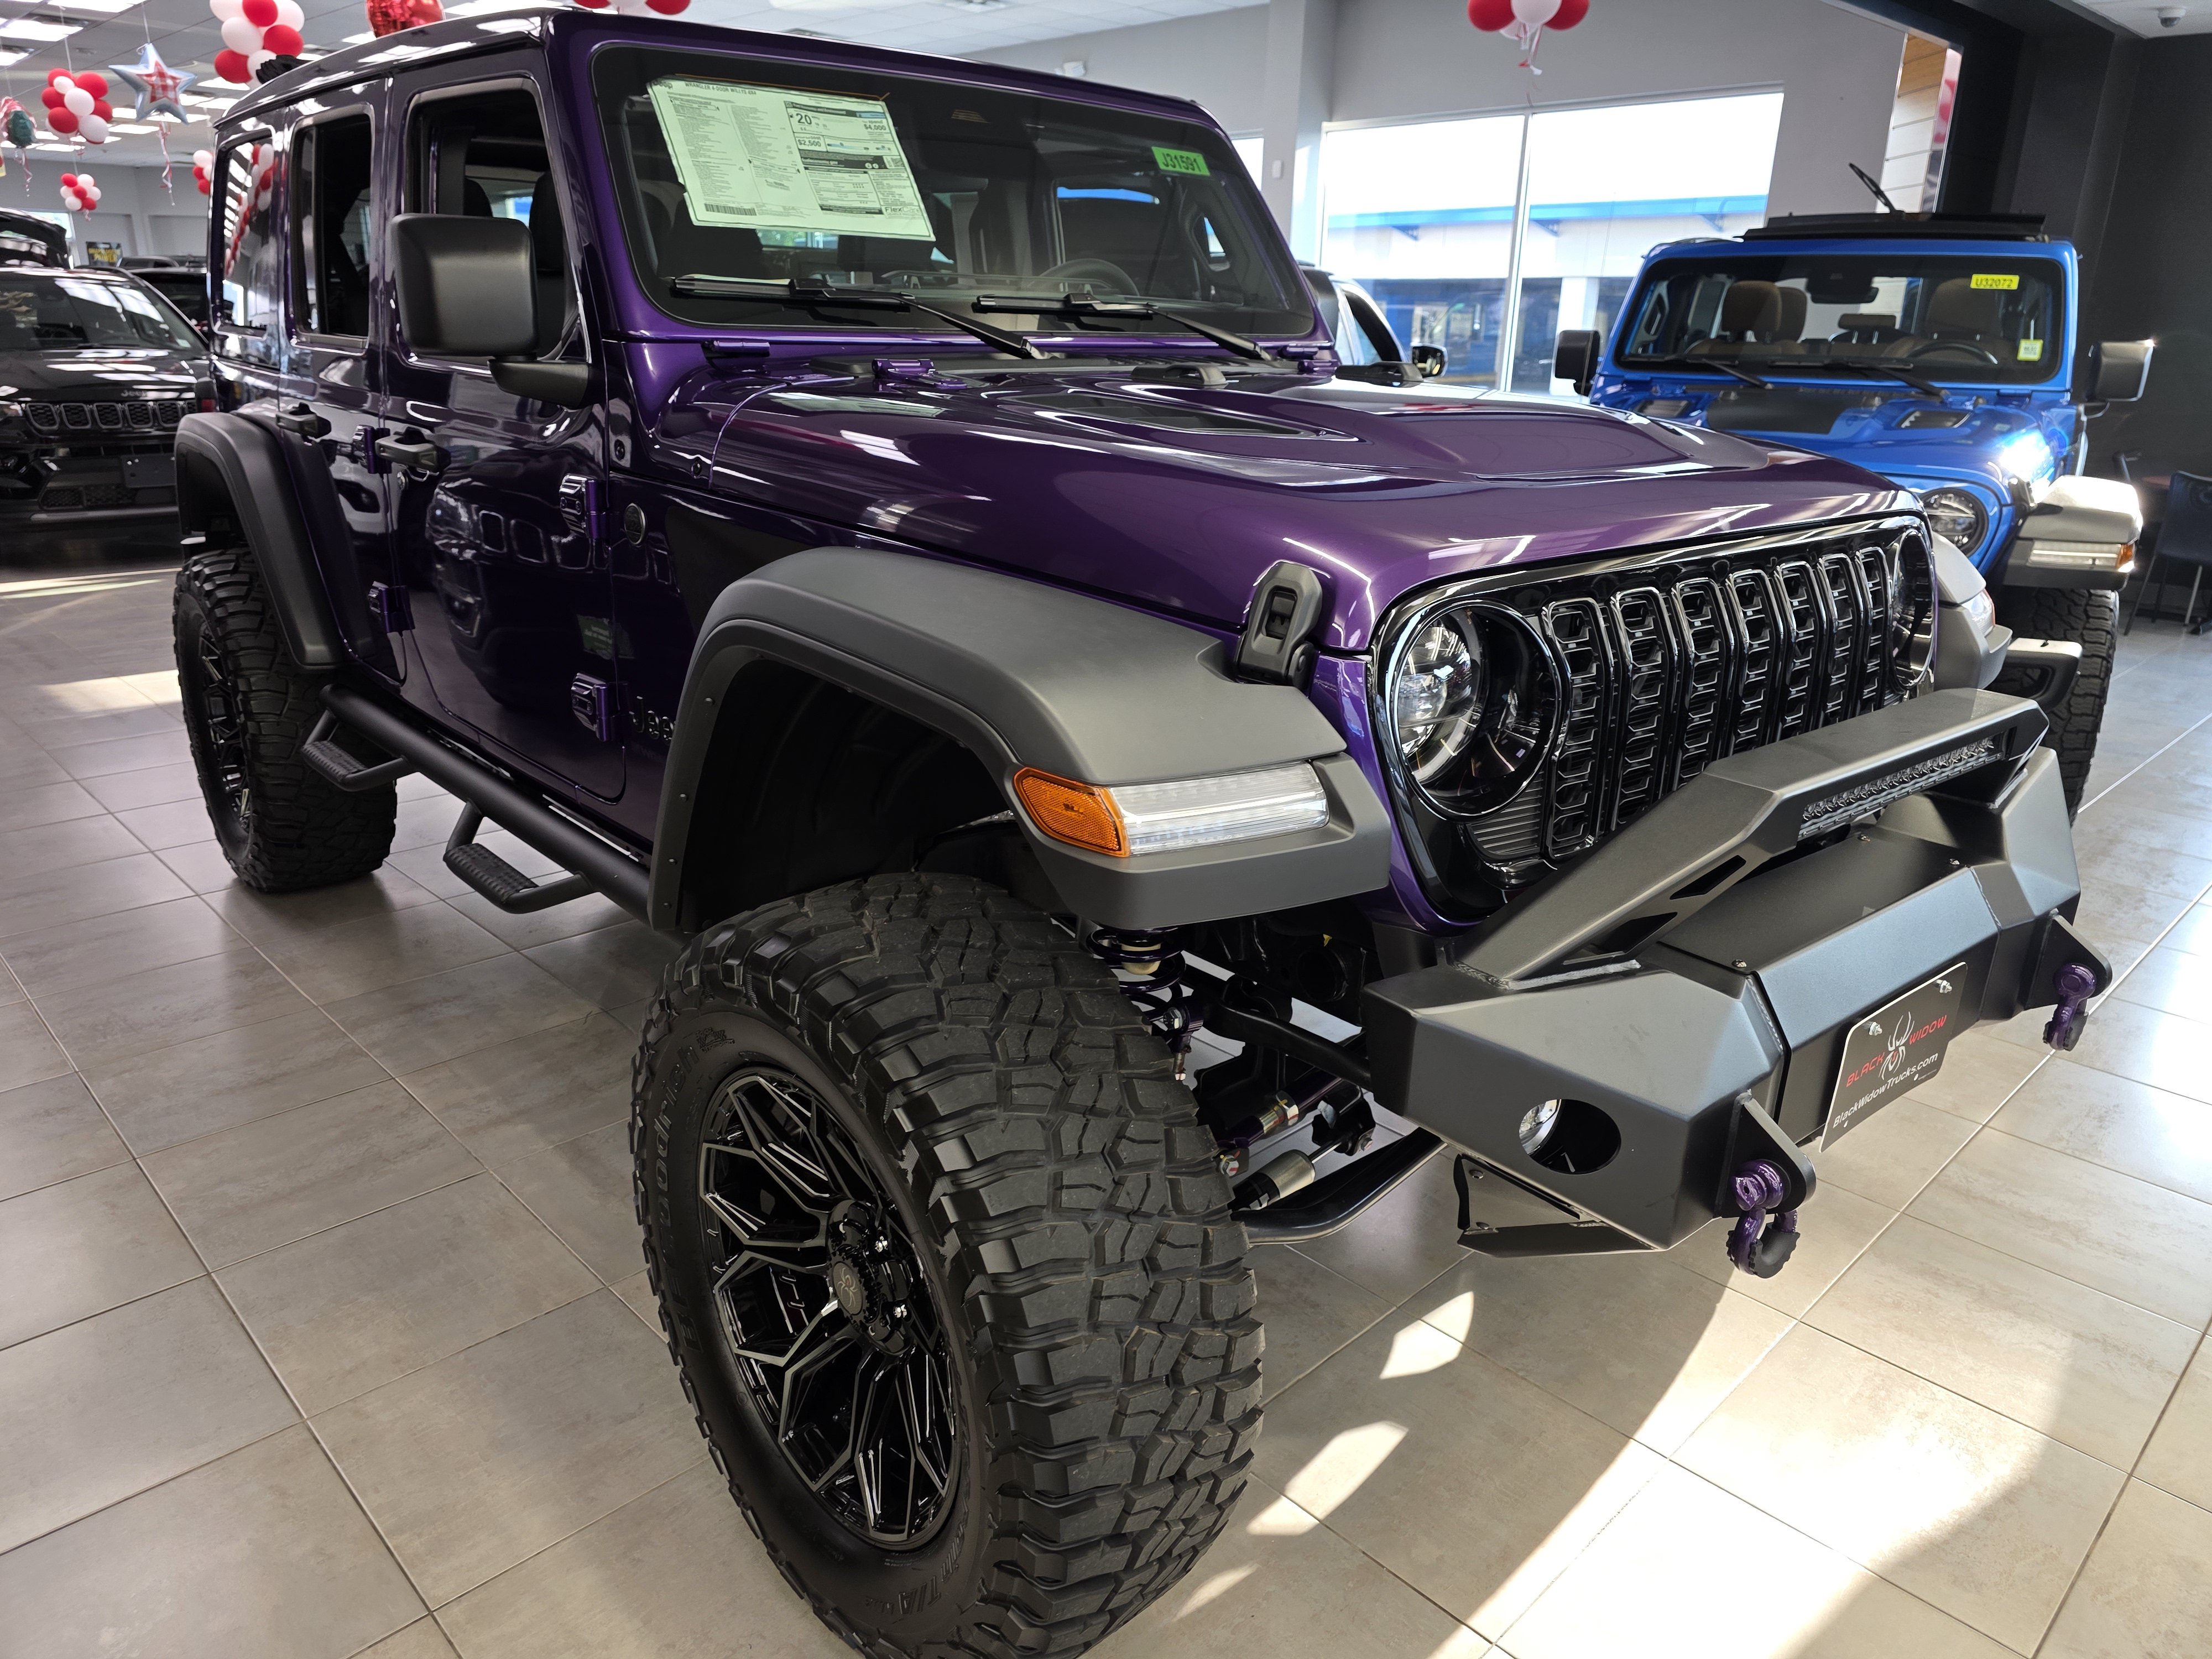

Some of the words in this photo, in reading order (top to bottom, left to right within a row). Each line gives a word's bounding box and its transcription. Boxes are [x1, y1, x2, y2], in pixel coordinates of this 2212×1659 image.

[795, 112, 812, 126] 20
[797, 139, 822, 147] $2,500
[629, 696, 674, 745] Jee
[1846, 1052, 1885, 1087] BLACK
[1910, 1015, 1947, 1045] WIDOW
[1833, 1053, 1938, 1128] BlackWidowTrucks.com
